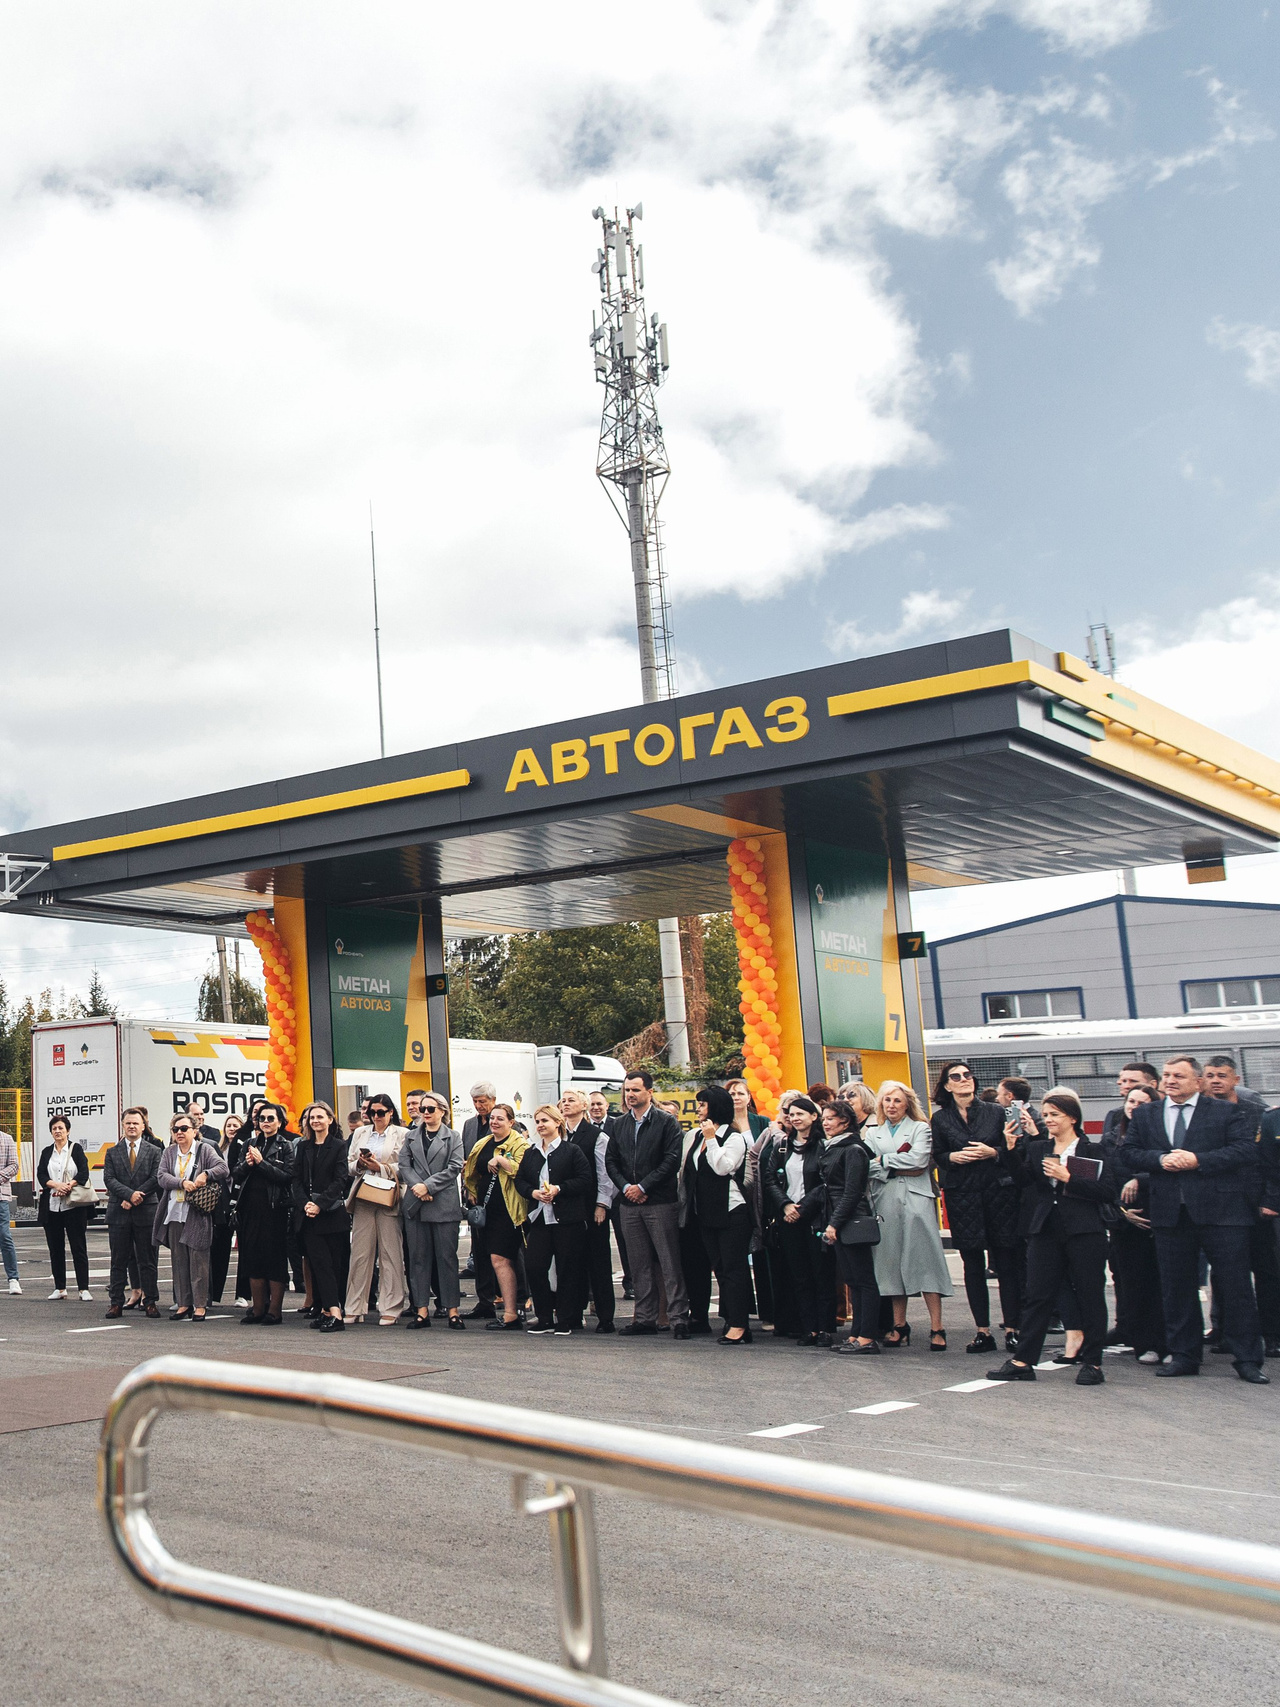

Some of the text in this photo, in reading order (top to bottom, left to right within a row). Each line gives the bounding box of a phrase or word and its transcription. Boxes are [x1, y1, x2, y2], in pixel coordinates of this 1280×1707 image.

[504, 696, 811, 793] АВТОГАЗ
[821, 930, 867, 954] МЕТАН
[908, 938, 921, 951] 7
[338, 975, 391, 994] МЕТАН
[436, 979, 445, 990] 9
[340, 996, 392, 1012] АВТОГАЗ
[889, 1013, 900, 1041] 7
[412, 1040, 425, 1062] 9
[172, 1067, 266, 1086] LADA SPO
[46, 1094, 105, 1104] LADA SPORT
[173, 1091, 265, 1114] ROSN
[47, 1104, 105, 1117] ROSNEFT
